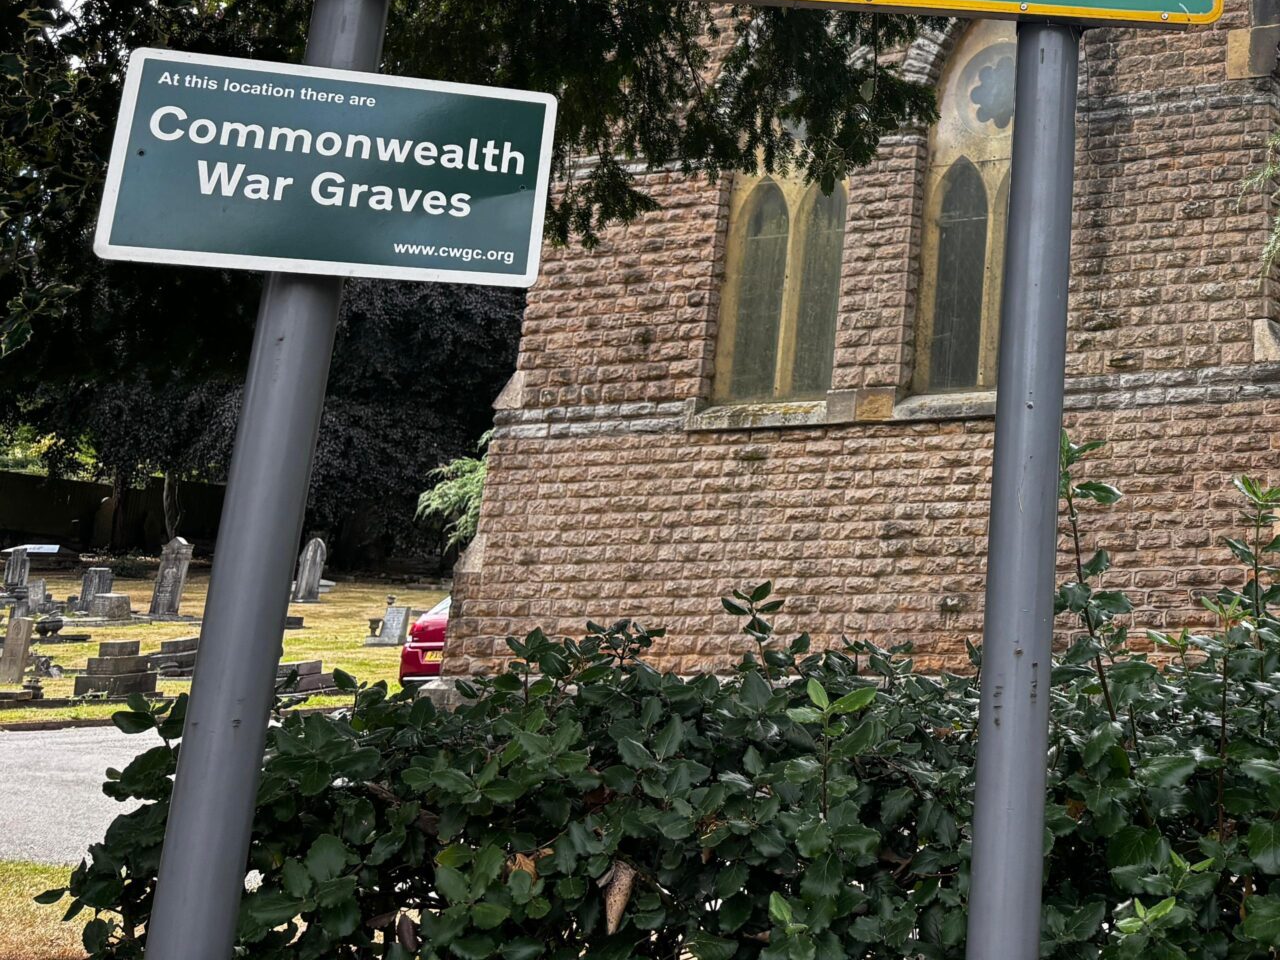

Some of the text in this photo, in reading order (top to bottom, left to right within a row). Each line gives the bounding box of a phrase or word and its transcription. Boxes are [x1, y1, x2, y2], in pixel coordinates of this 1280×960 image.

[158, 72, 376, 108] At this location there are
[149, 106, 525, 175] Commonwealth
[197, 160, 472, 217] War Graves
[394, 242, 514, 265] www.cwgc.org
